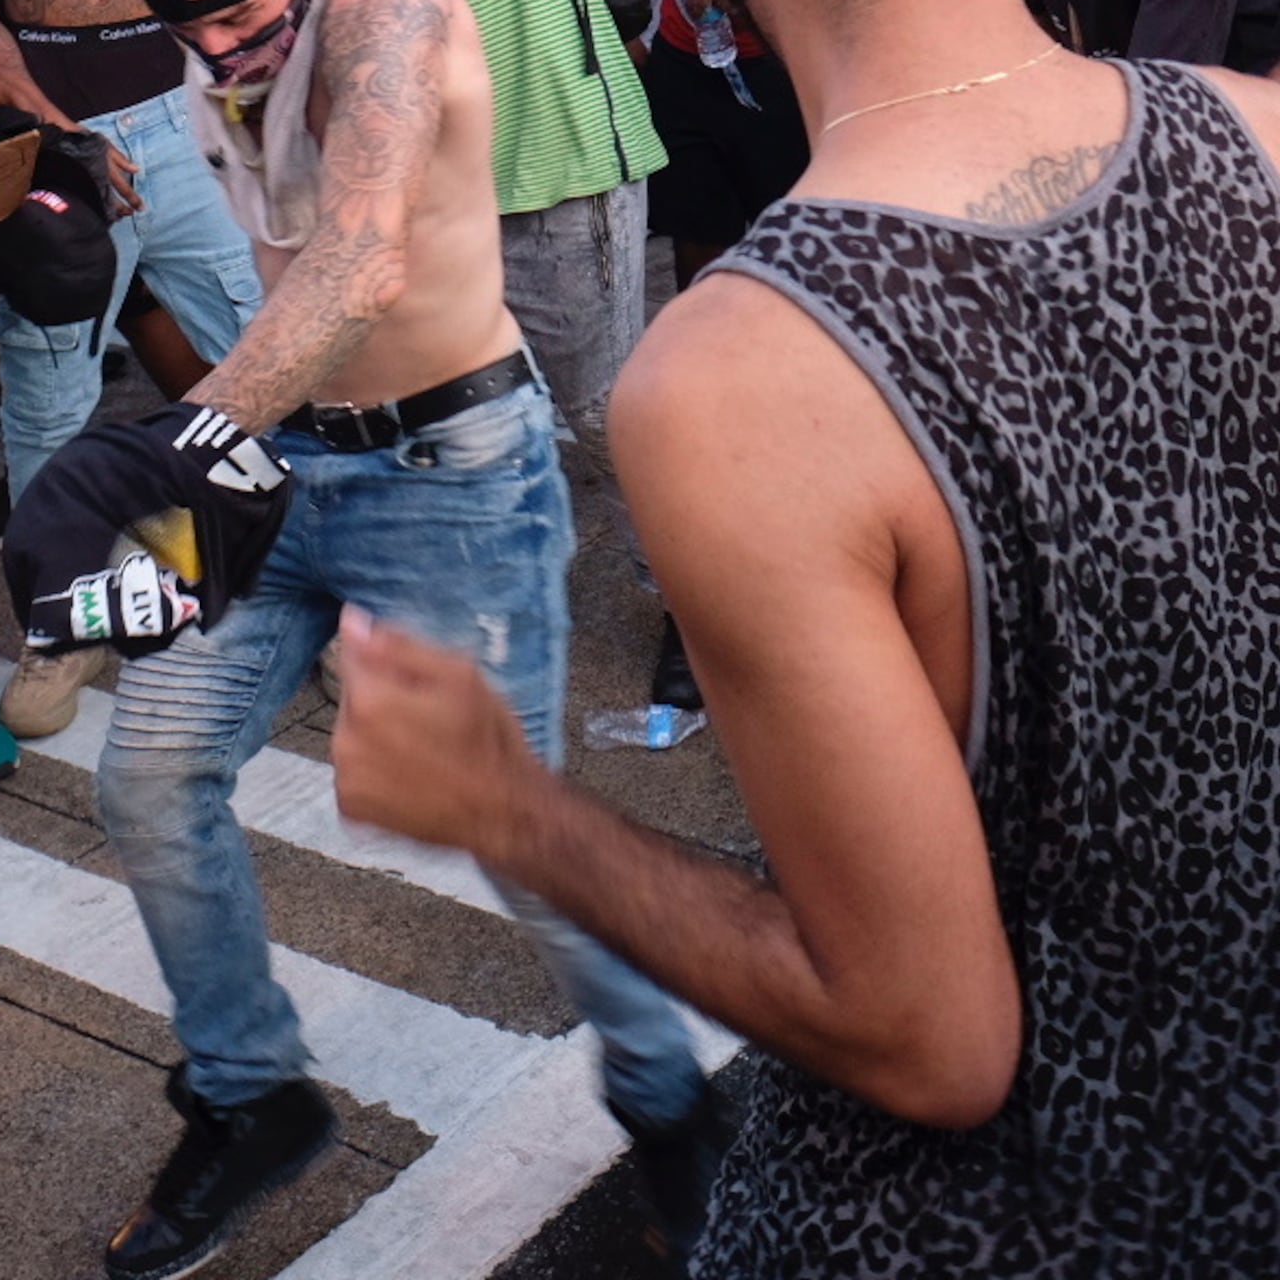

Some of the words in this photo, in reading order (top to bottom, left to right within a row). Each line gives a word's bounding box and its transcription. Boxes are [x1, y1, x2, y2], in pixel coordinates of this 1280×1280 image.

[18, 29, 50, 43] Calvin
[51, 31, 77, 44] Klein
[98, 27, 135, 41] Calvin
